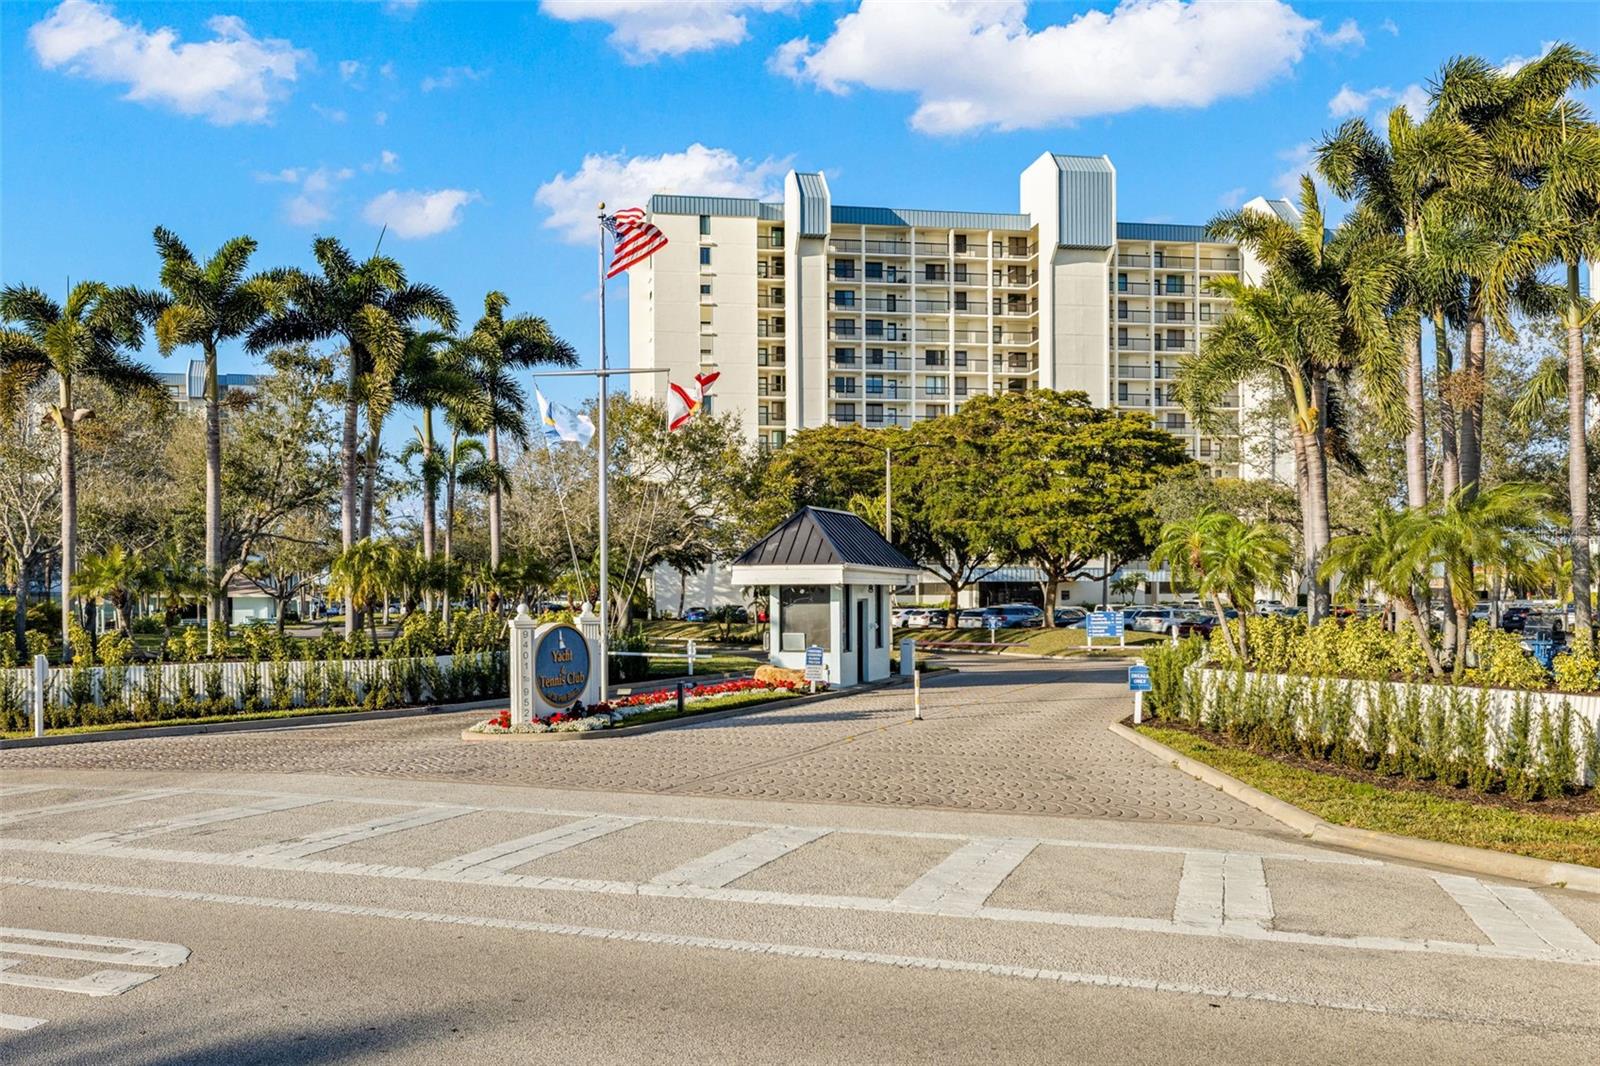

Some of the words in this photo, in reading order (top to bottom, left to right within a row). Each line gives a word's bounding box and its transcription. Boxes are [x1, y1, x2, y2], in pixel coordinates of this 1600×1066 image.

[522, 630, 530, 670] 9401
[552, 650, 573, 662] Yacht
[541, 675, 566, 688] Tennis
[567, 671, 585, 685] Club
